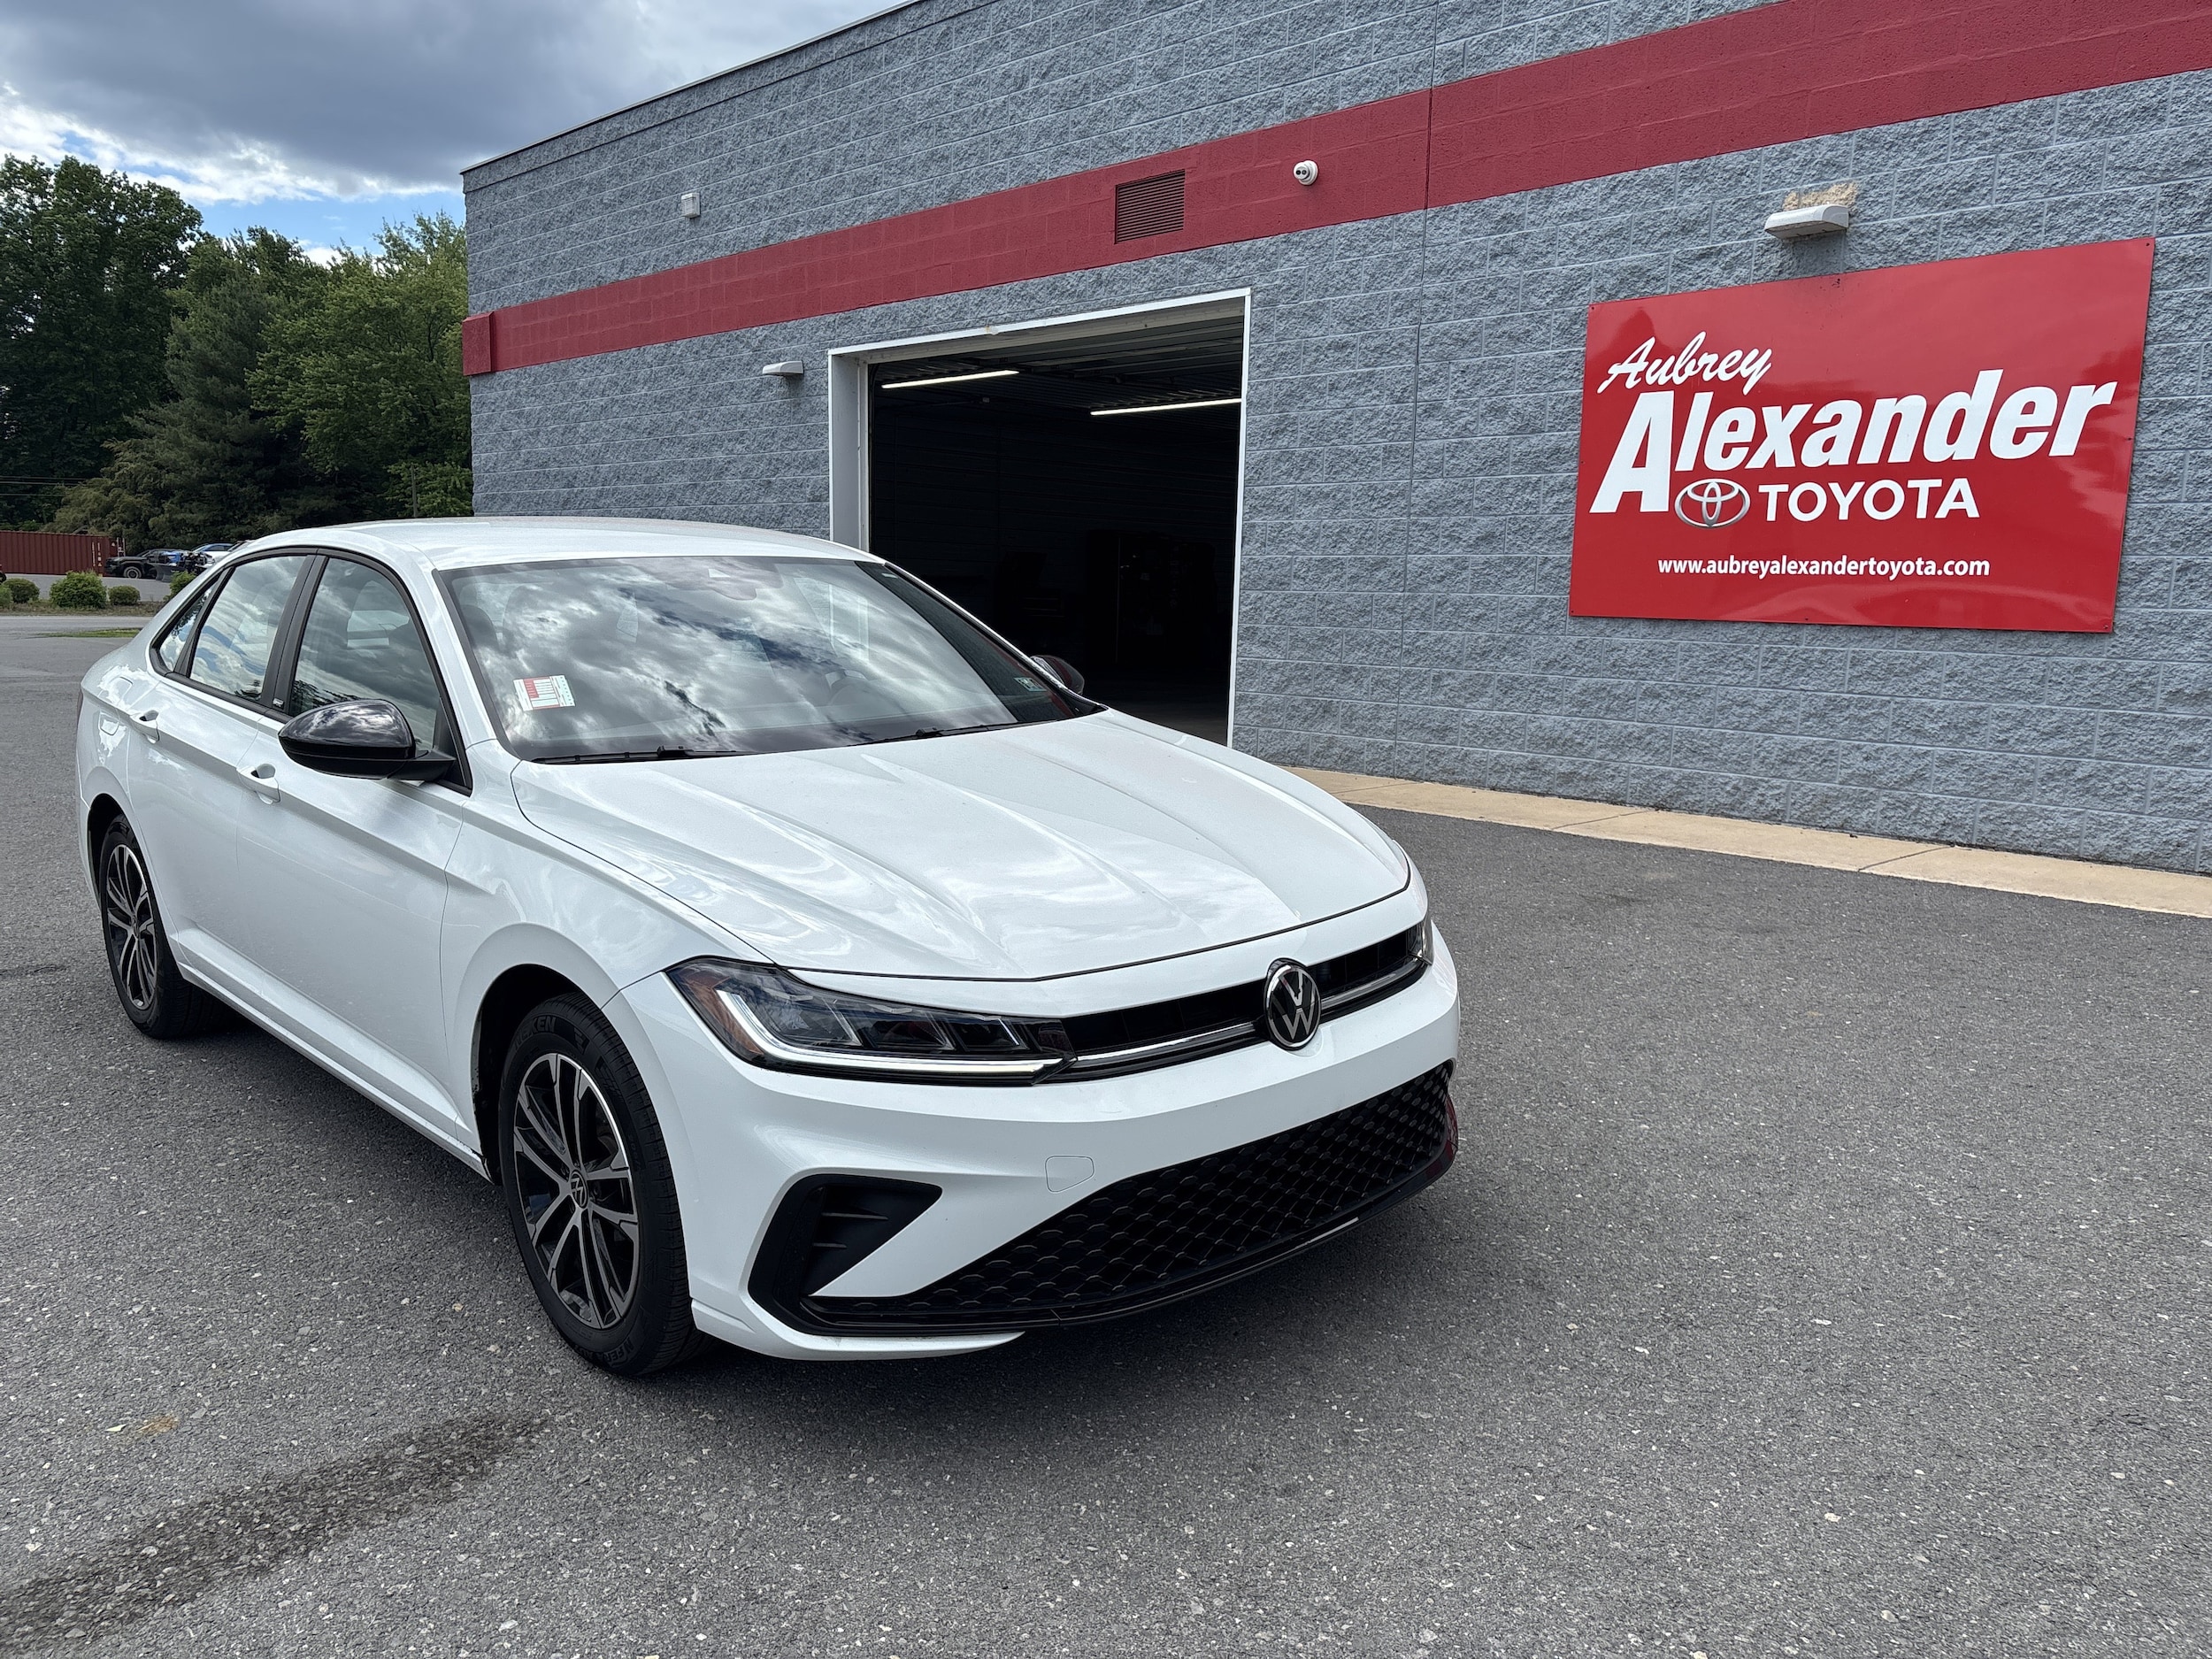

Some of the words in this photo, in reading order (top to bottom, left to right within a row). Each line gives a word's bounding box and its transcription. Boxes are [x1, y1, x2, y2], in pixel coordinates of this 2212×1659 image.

[1598, 331, 1772, 396] Aubrey
[1590, 369, 2118, 513] Alexander
[1758, 478, 1980, 522] TOYOTA
[1657, 554, 1991, 581] www.aubreyalexandertoyota.com
